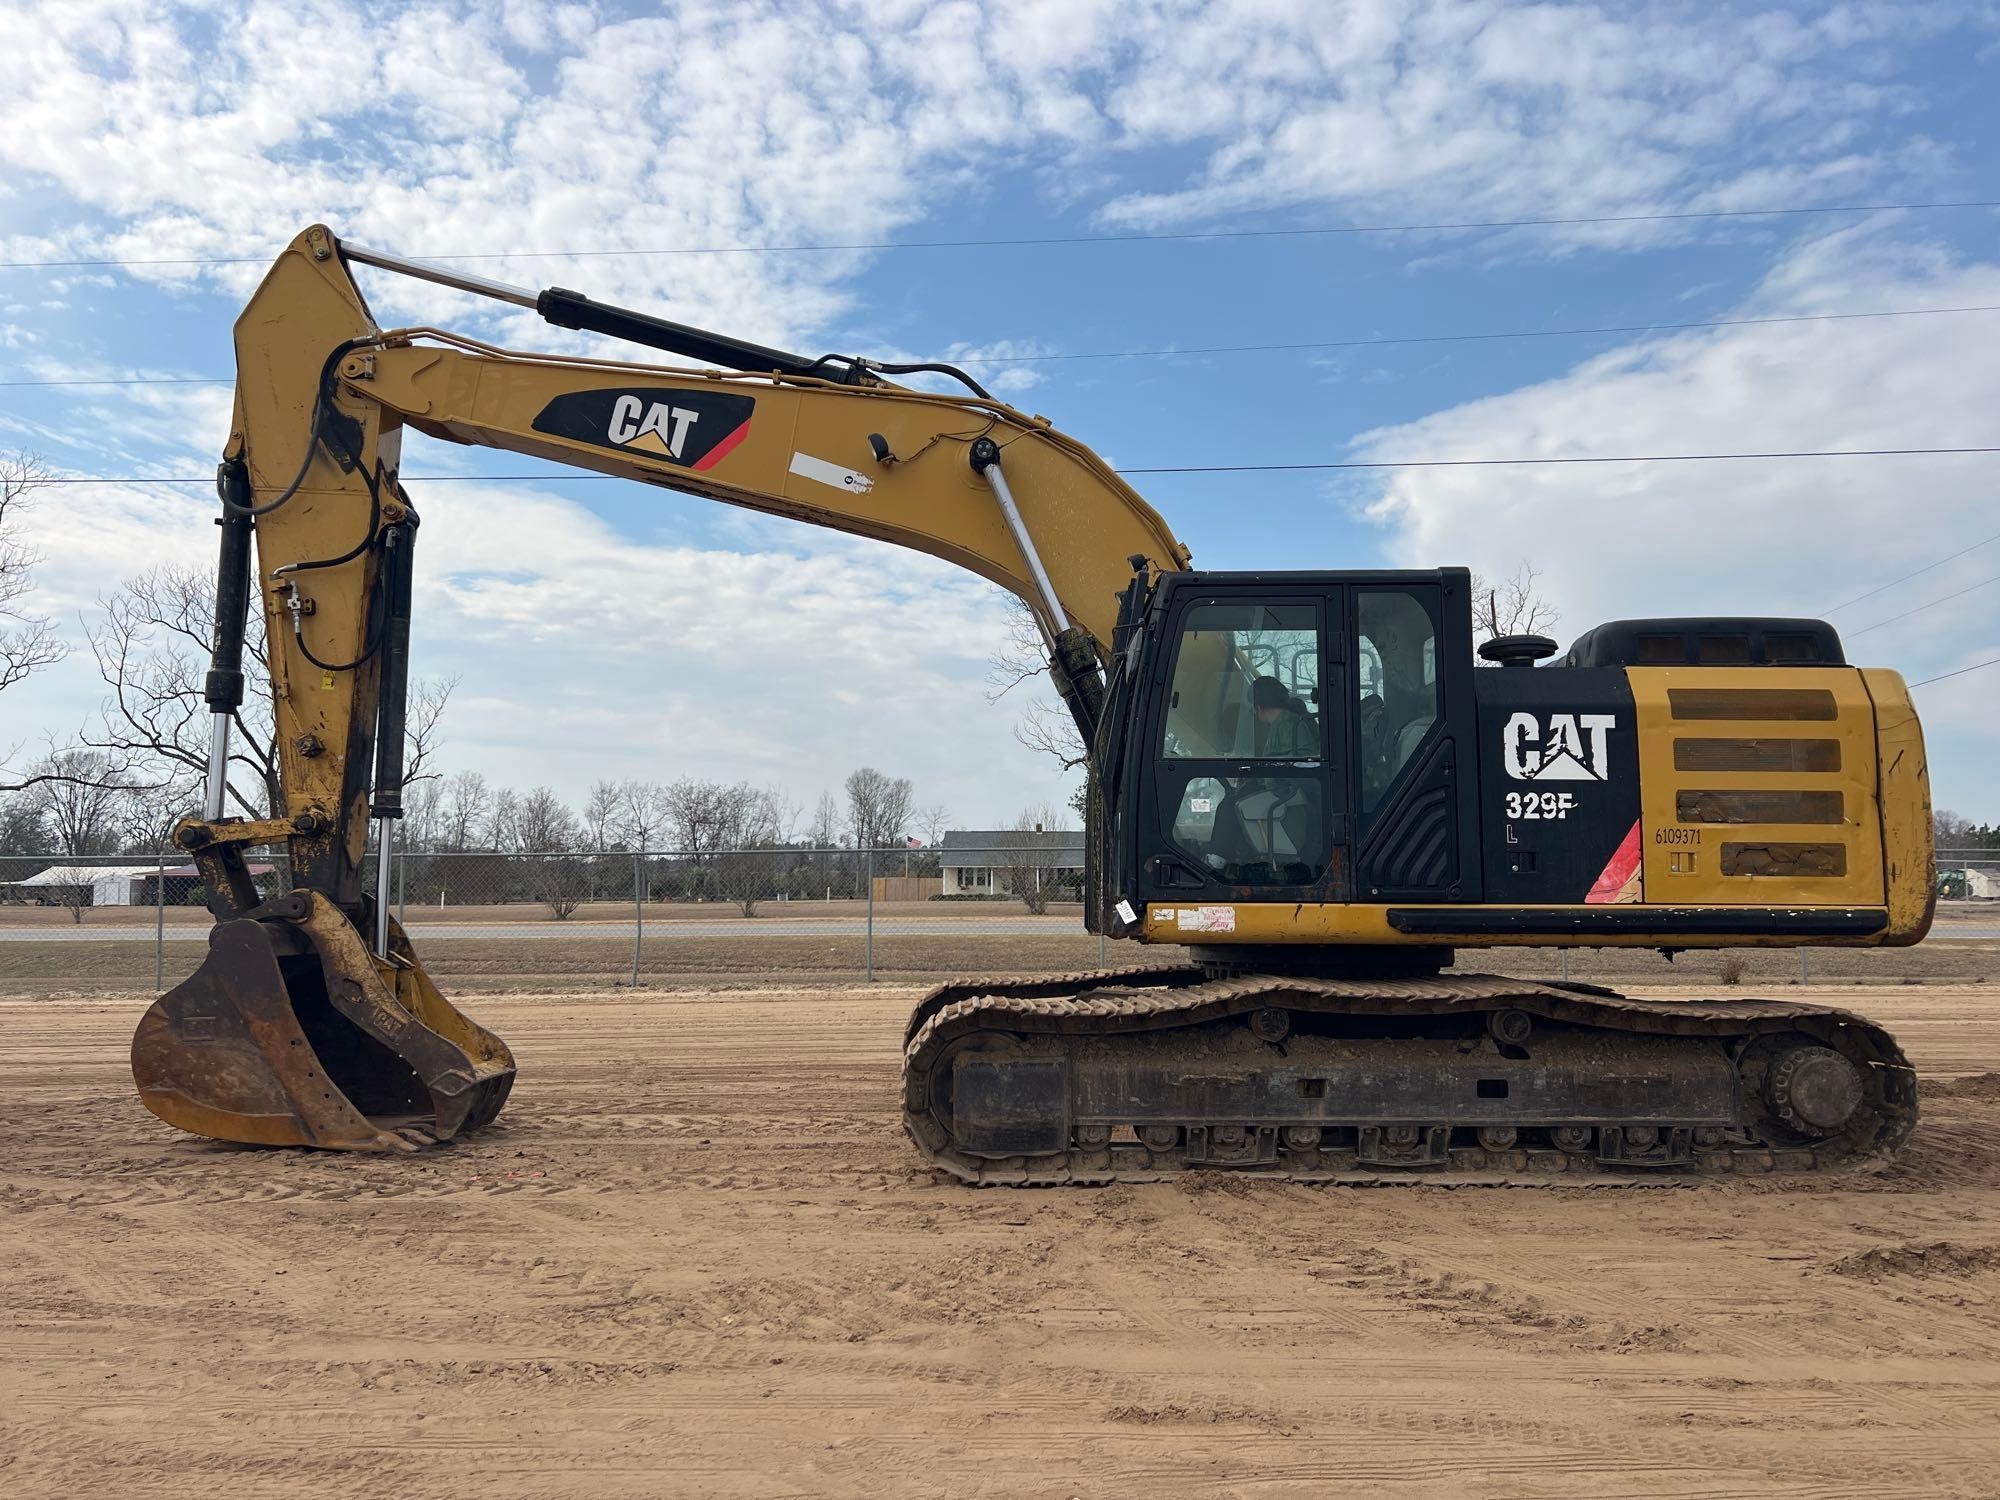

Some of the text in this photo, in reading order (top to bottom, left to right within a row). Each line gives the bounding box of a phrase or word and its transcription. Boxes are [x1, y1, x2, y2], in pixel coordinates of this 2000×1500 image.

[608, 394, 699, 458] CAT
[1503, 712, 1615, 780] CAT
[1505, 792, 1576, 819] 329F
[1506, 824, 1518, 843] L
[1656, 828, 1701, 844] 6109371
[378, 1010, 403, 1034] CAT
